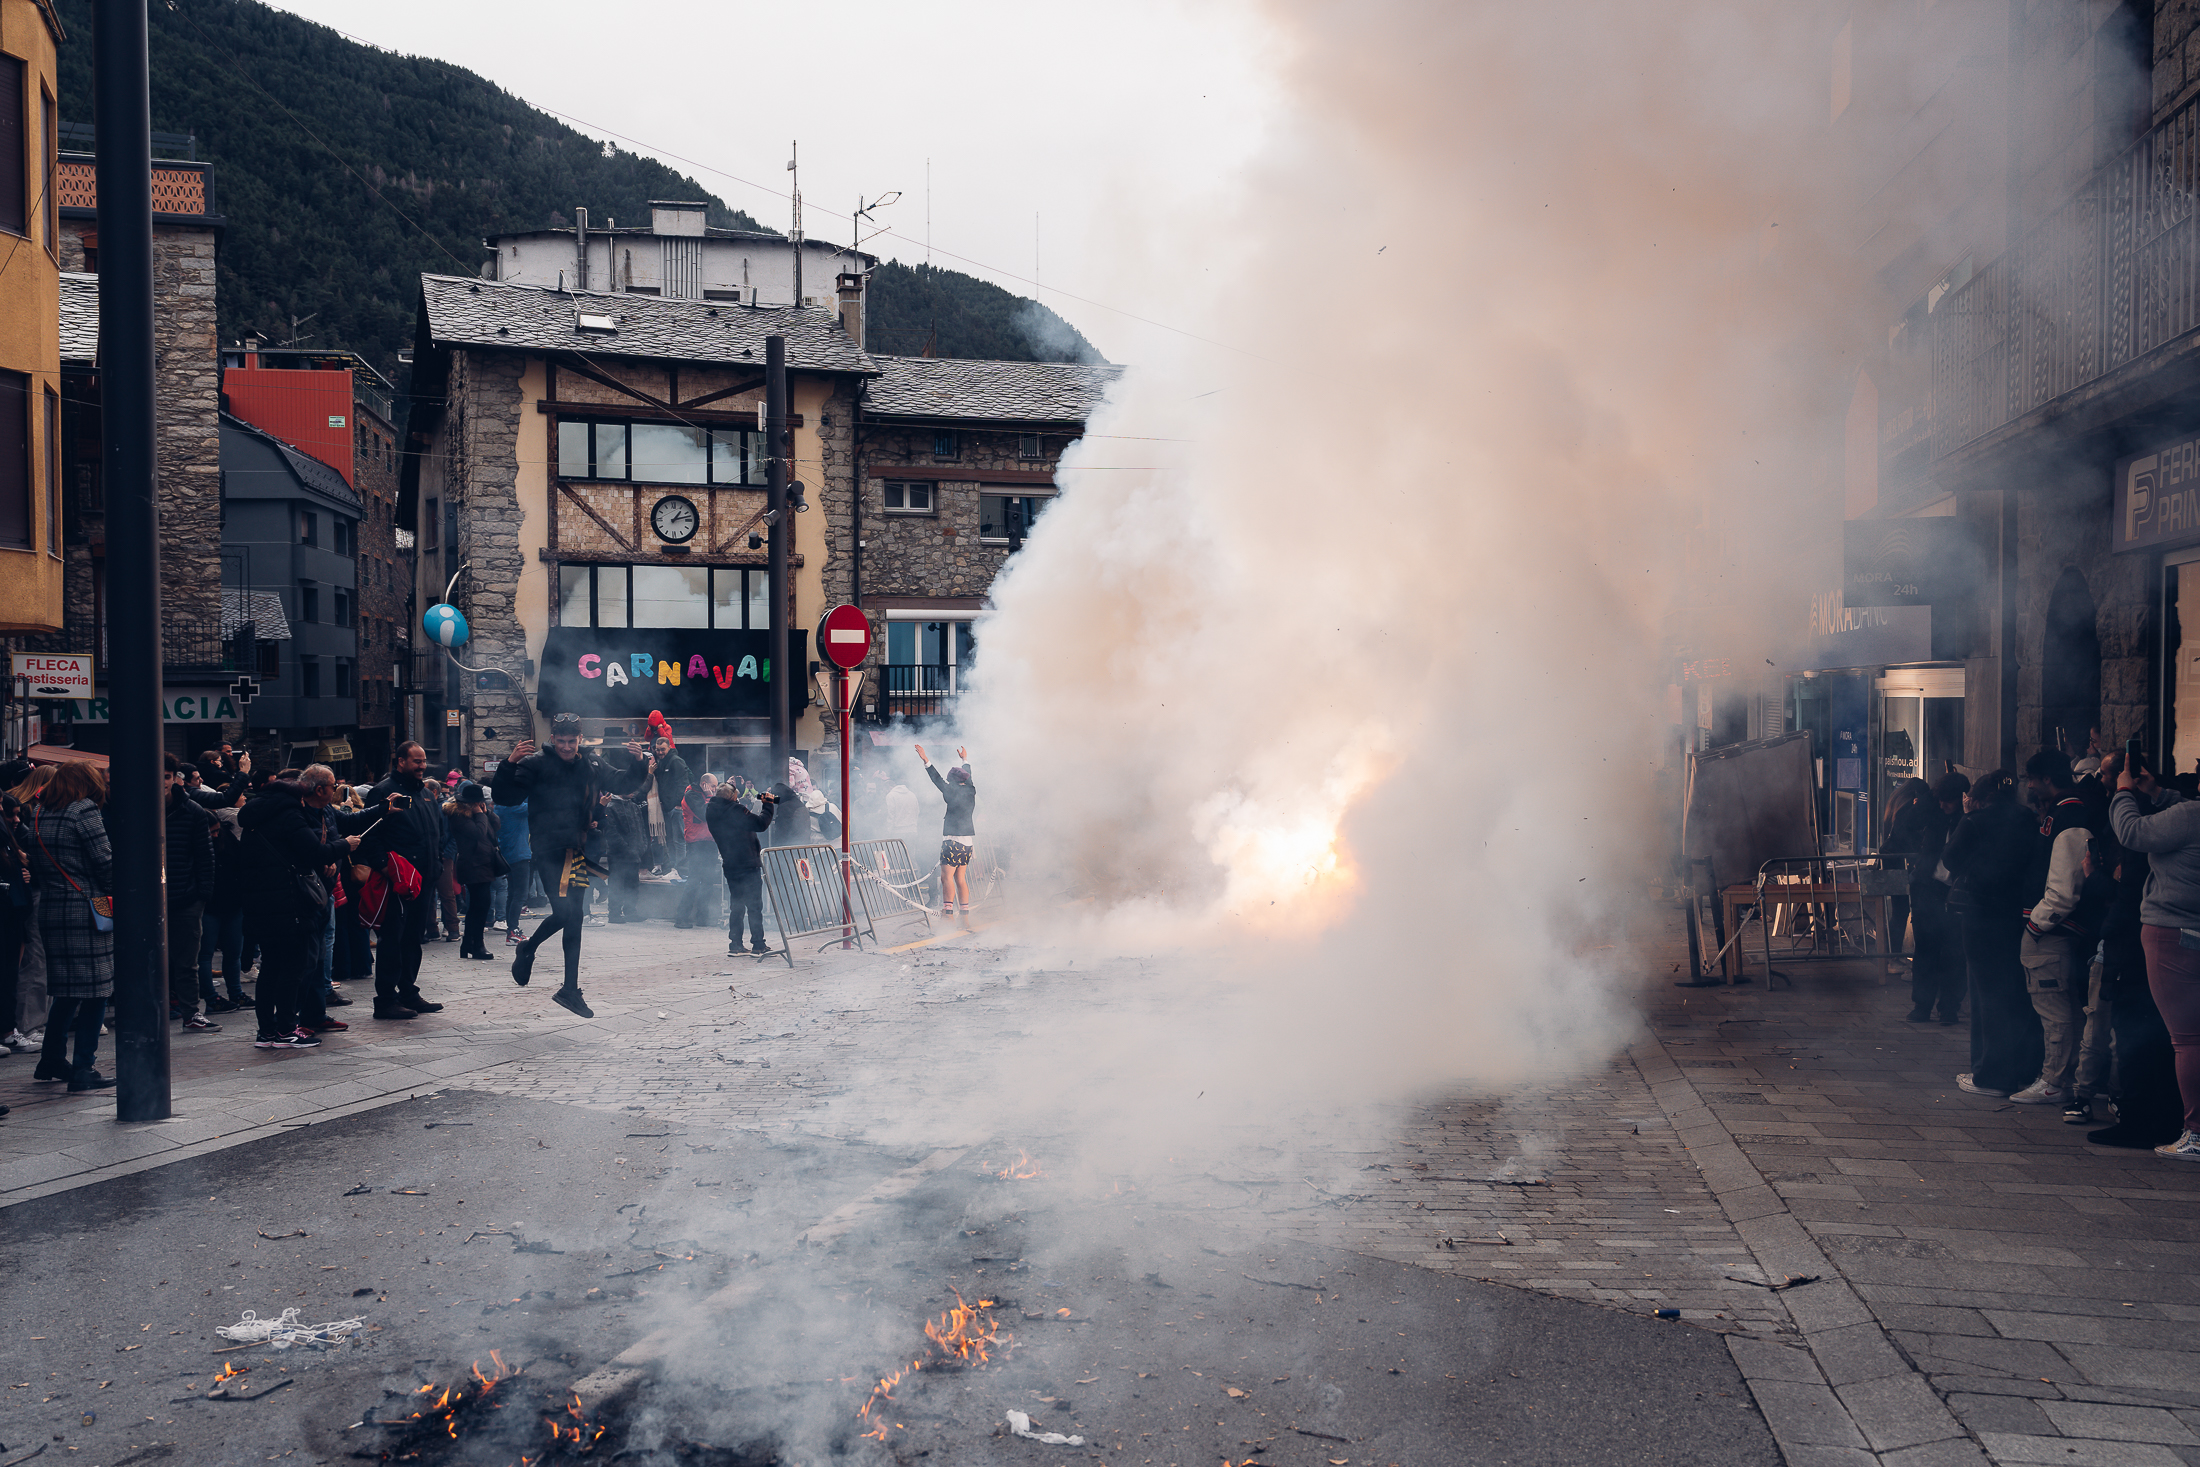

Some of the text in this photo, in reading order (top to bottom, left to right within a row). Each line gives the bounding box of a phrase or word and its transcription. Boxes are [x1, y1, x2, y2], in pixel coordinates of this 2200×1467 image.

[1893, 584, 1918, 596] 24h
[26, 658, 80, 671] FLECA
[17, 672, 89, 685] Pastisseria
[60, 696, 237, 720] ARCIA
